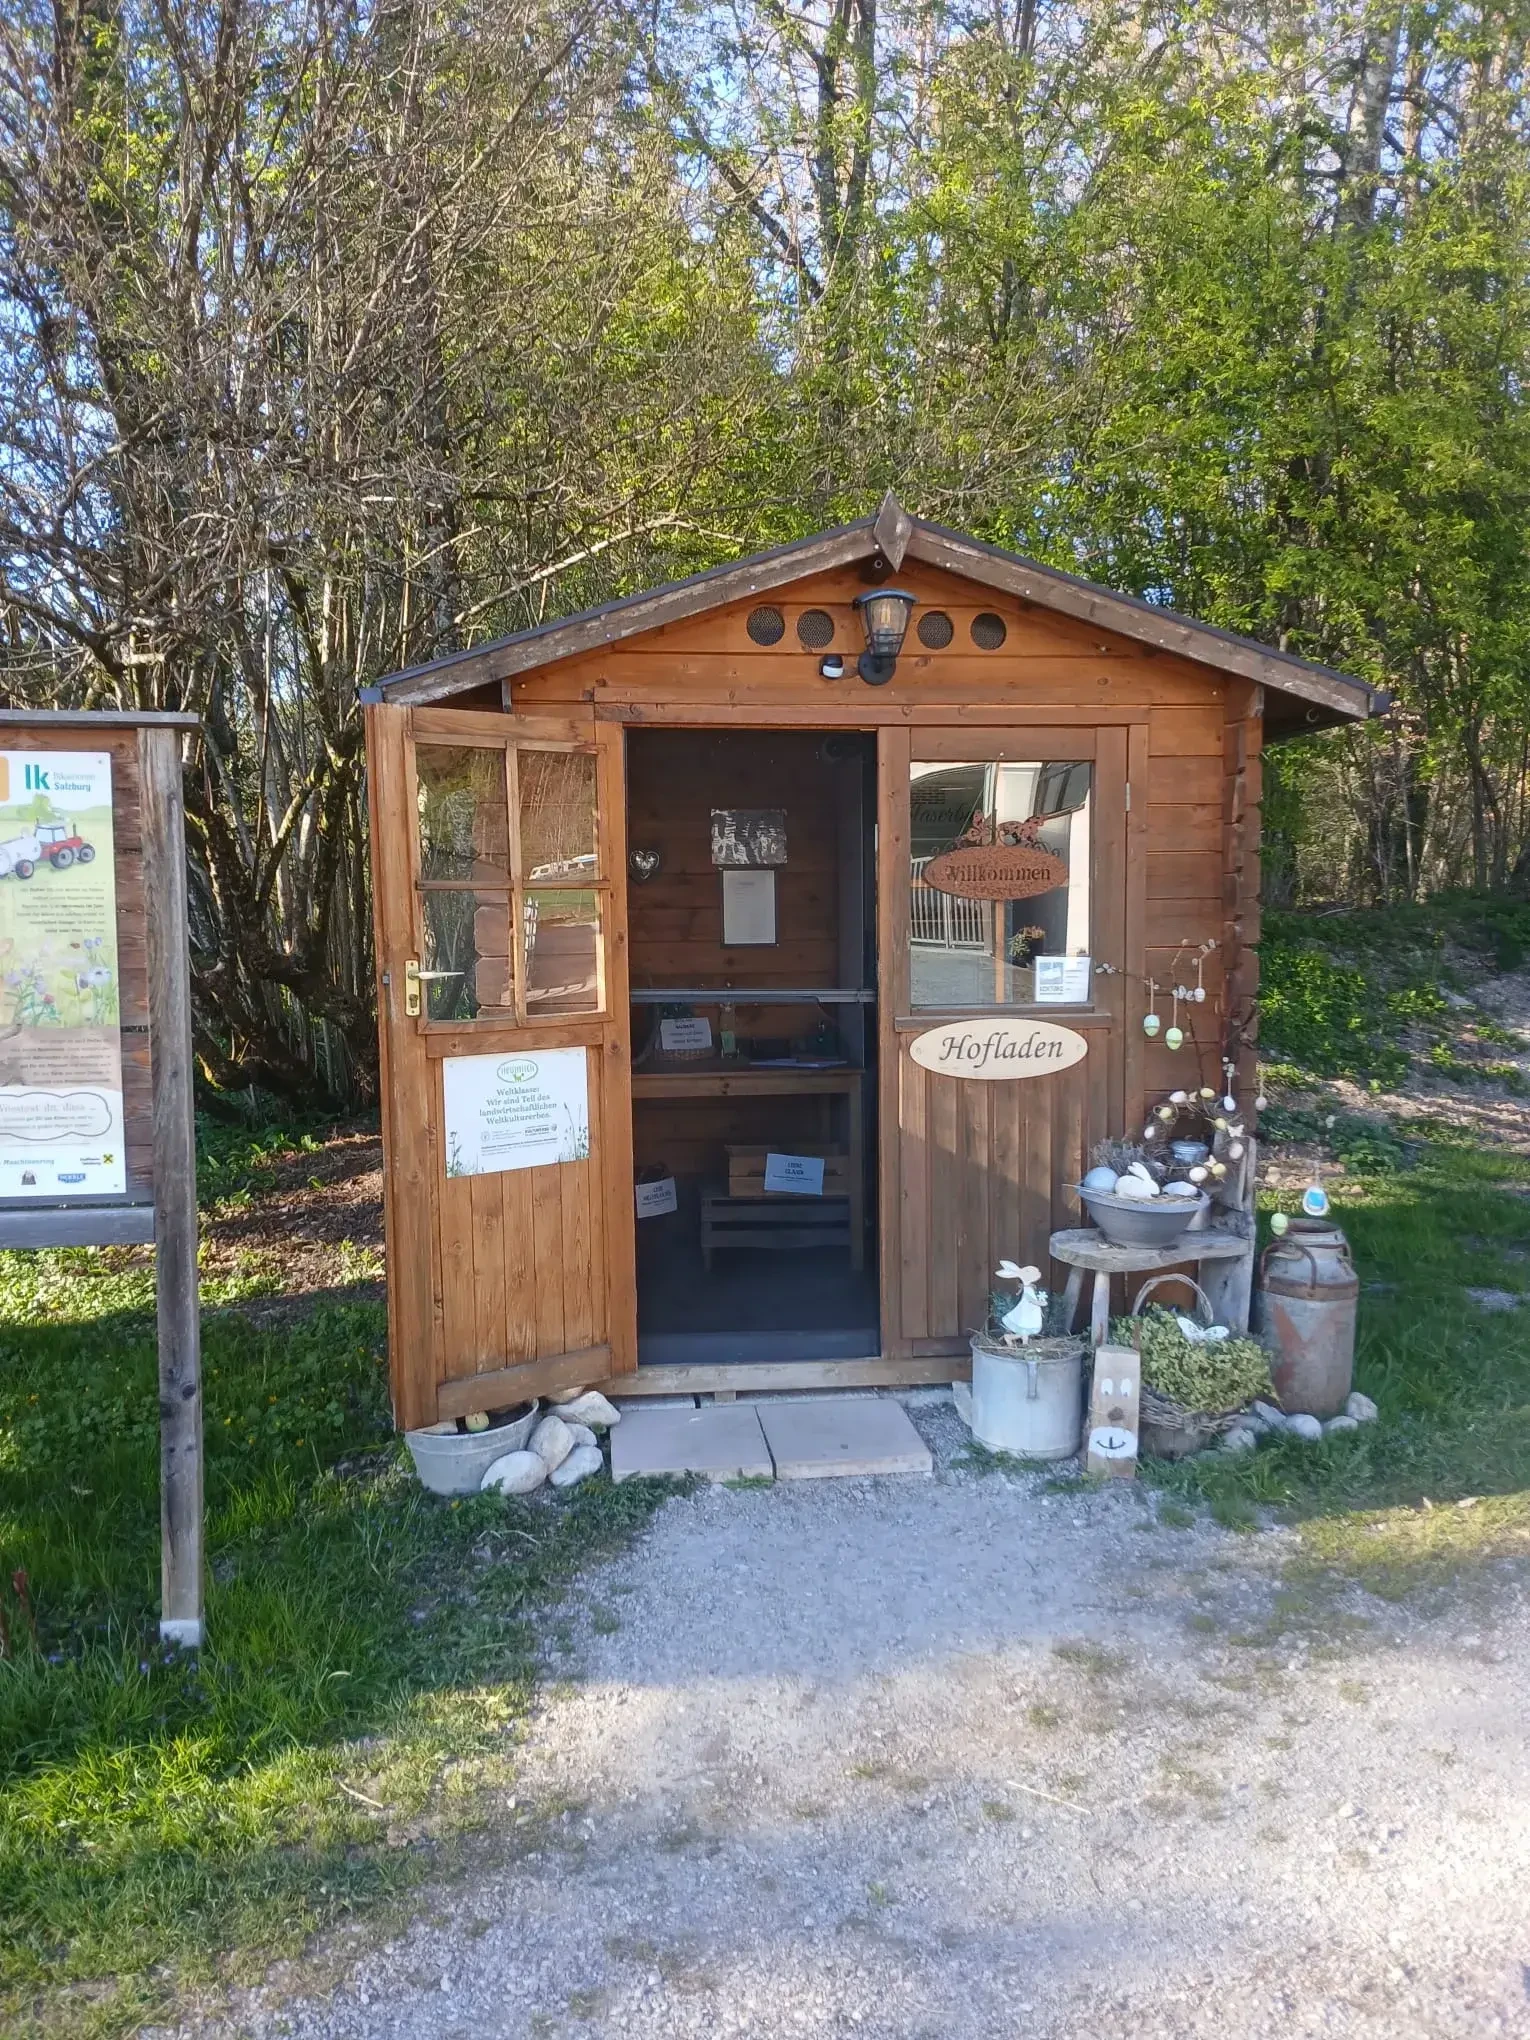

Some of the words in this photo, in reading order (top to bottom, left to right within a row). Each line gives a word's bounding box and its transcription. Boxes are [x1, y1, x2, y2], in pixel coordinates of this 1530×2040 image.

[54, 782, 91, 792] Salzburg
[945, 864, 1050, 882] Willkommen
[938, 1032, 1064, 1068] Hofladen
[486, 1099, 501, 1107] Wir
[503, 1096, 520, 1105] sind
[521, 1094, 536, 1103] Teil
[537, 1093, 551, 1101] des
[479, 1102, 557, 1117] landwirtschaftlichen
